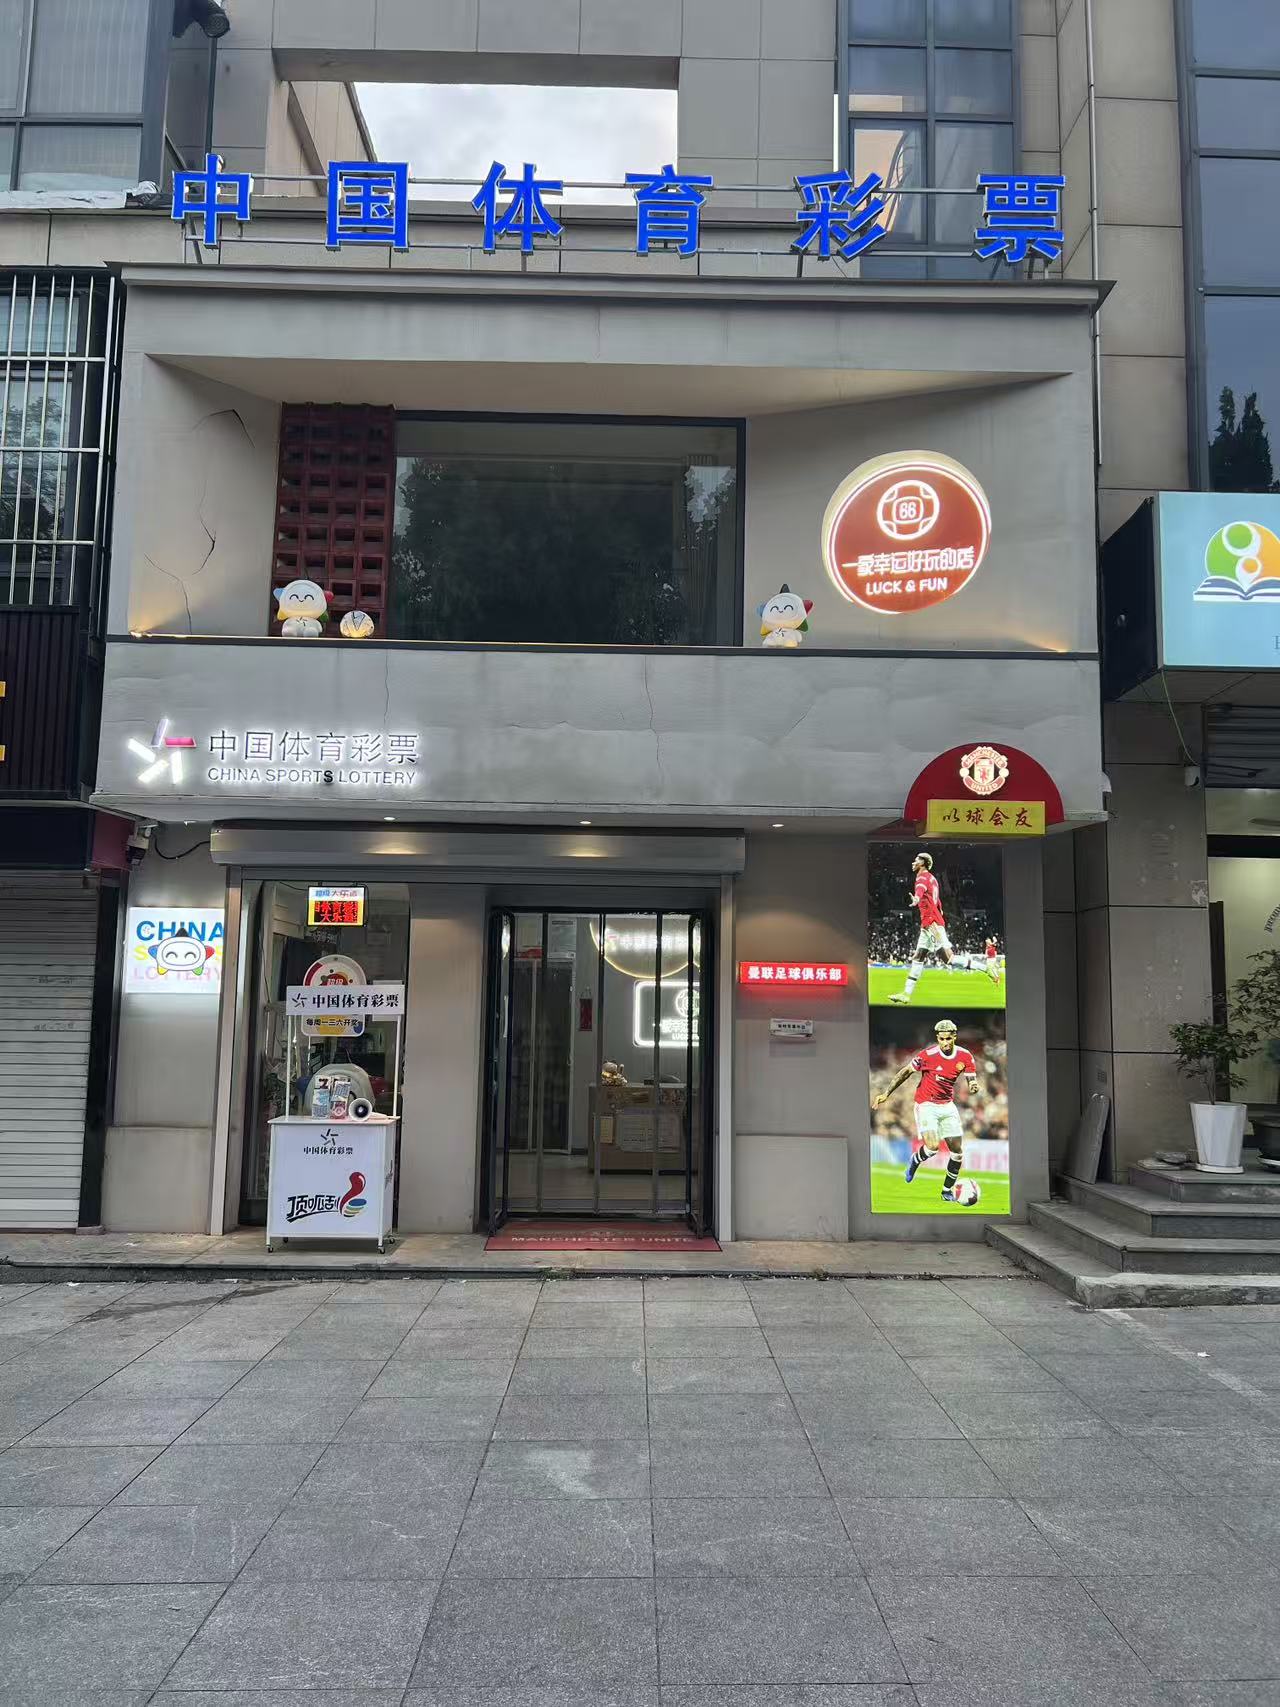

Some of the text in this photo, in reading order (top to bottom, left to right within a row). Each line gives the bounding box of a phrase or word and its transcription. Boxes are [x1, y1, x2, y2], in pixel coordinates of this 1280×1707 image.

[171, 153, 1066, 263] 中国体育彩票
[900, 502, 917, 519] 66
[842, 545, 974, 576] 一家幸运好玩的店
[866, 577, 948, 595] LUCK & FUN
[209, 729, 418, 764] 中国体育彩票
[207, 767, 416, 785] CHINA SPORTS LOTTERY
[942, 807, 1032, 828] 以球会友
[748, 966, 842, 981] 曼联足球俱乐部
[312, 993, 399, 1008] 中国体育彩票
[303, 1146, 353, 1155] 中国体育彩票
